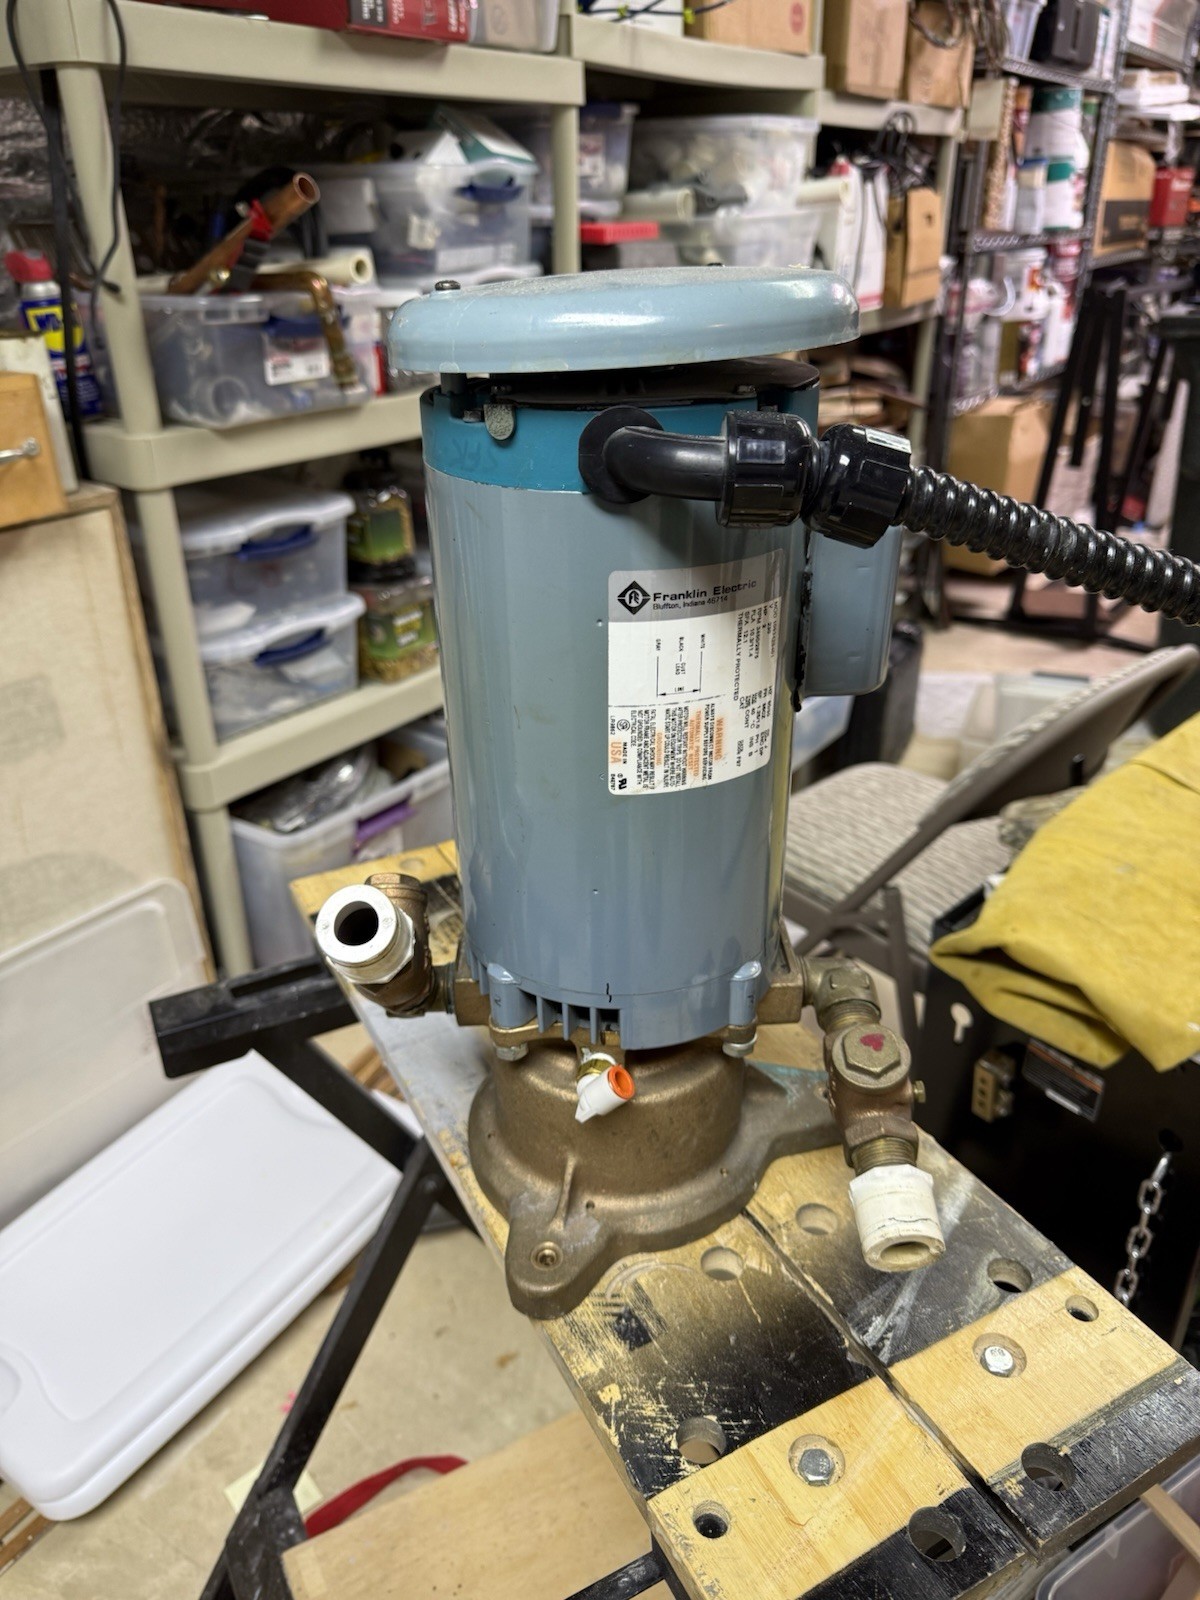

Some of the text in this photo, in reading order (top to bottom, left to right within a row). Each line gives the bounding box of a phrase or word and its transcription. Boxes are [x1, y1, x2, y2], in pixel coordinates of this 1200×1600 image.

[653, 580, 757, 602] Franklin Electric
[652, 602, 682, 611] Bluffton,
[683, 600, 705, 608] Indiana
[736, 612, 744, 656] THERMALLY
[714, 718, 723, 761] WARNING
[611, 742, 622, 763] USA
